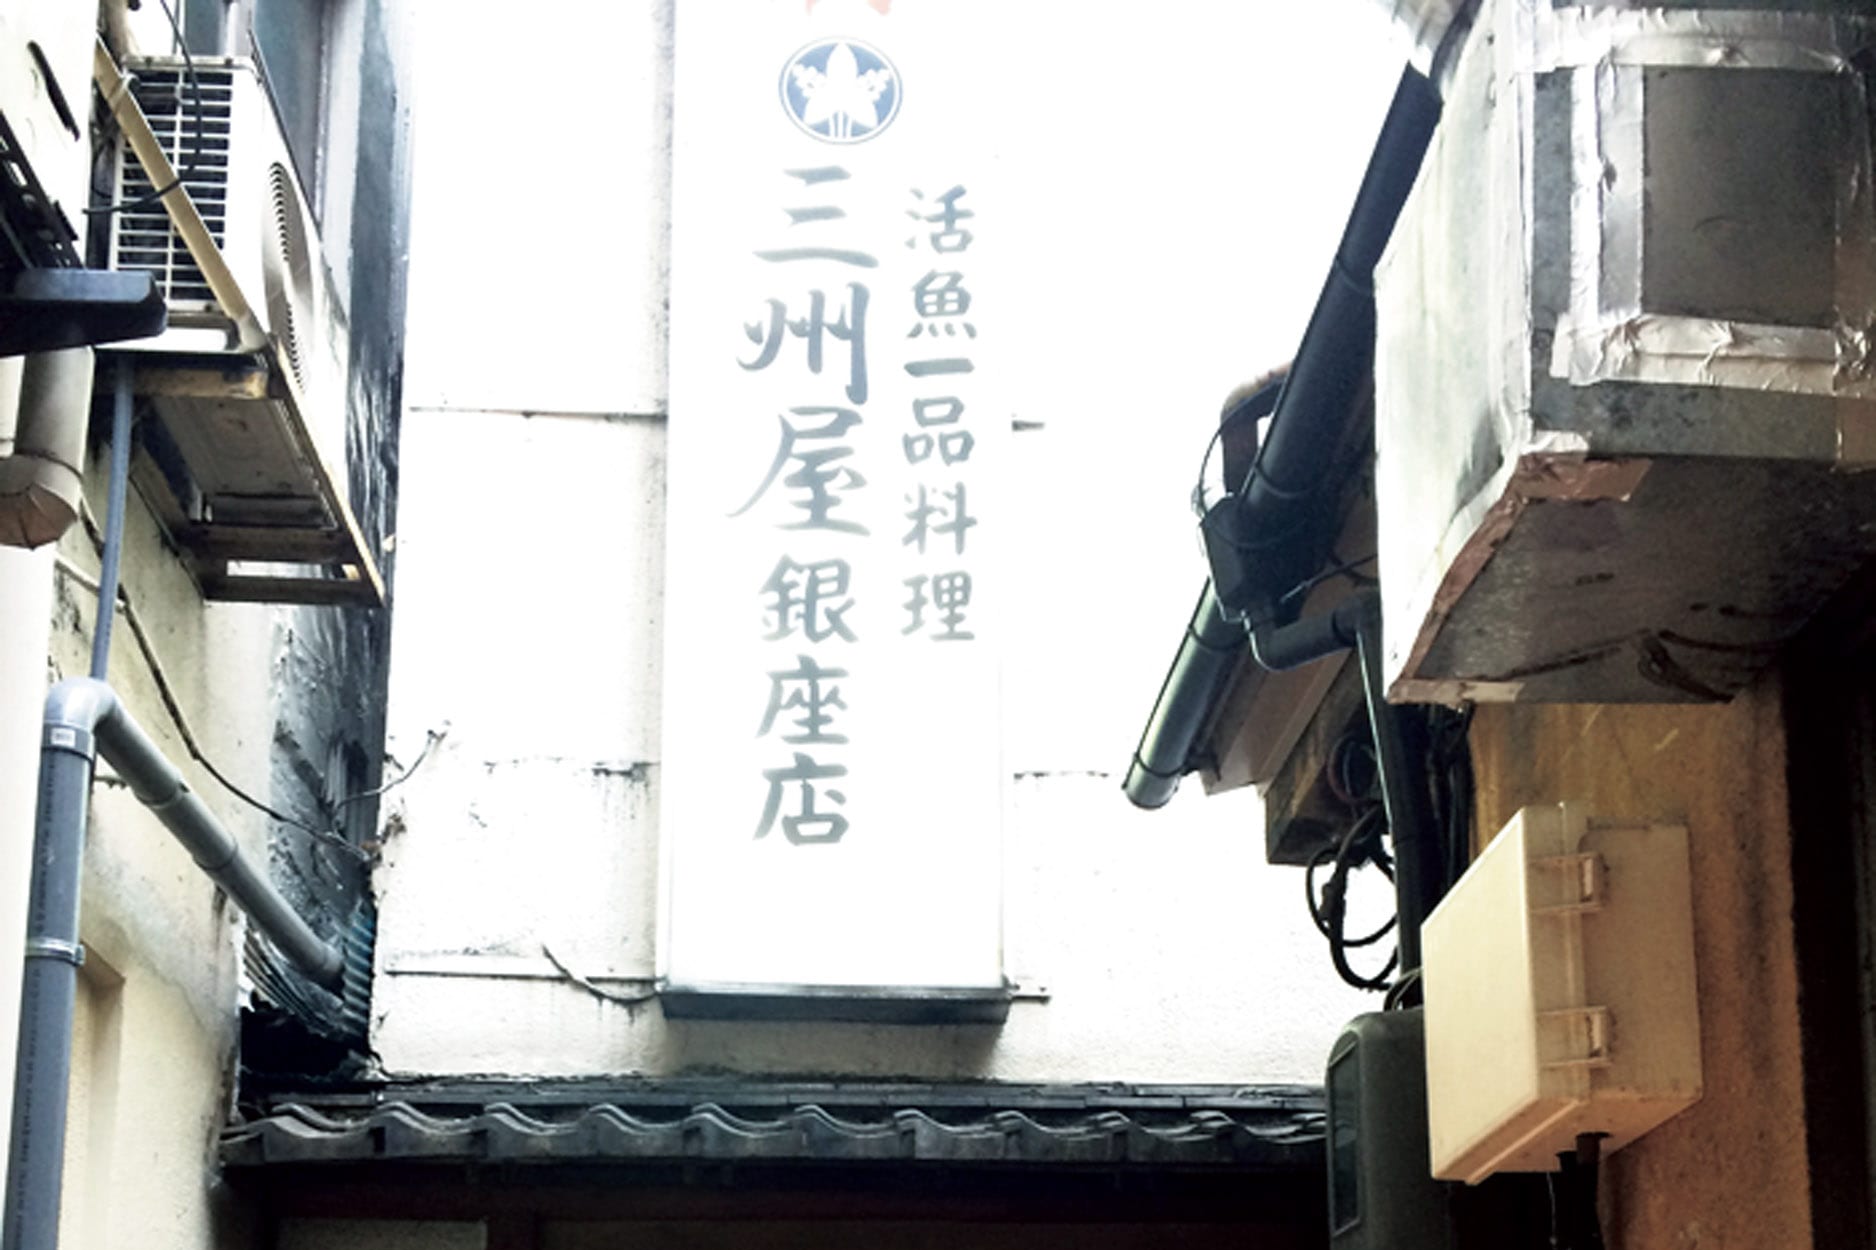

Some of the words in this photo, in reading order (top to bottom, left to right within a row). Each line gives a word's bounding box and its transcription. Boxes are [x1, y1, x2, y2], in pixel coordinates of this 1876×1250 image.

[728, 165, 879, 847] 三州屋銀座店
[901, 184, 978, 643] 活魚一品料理
